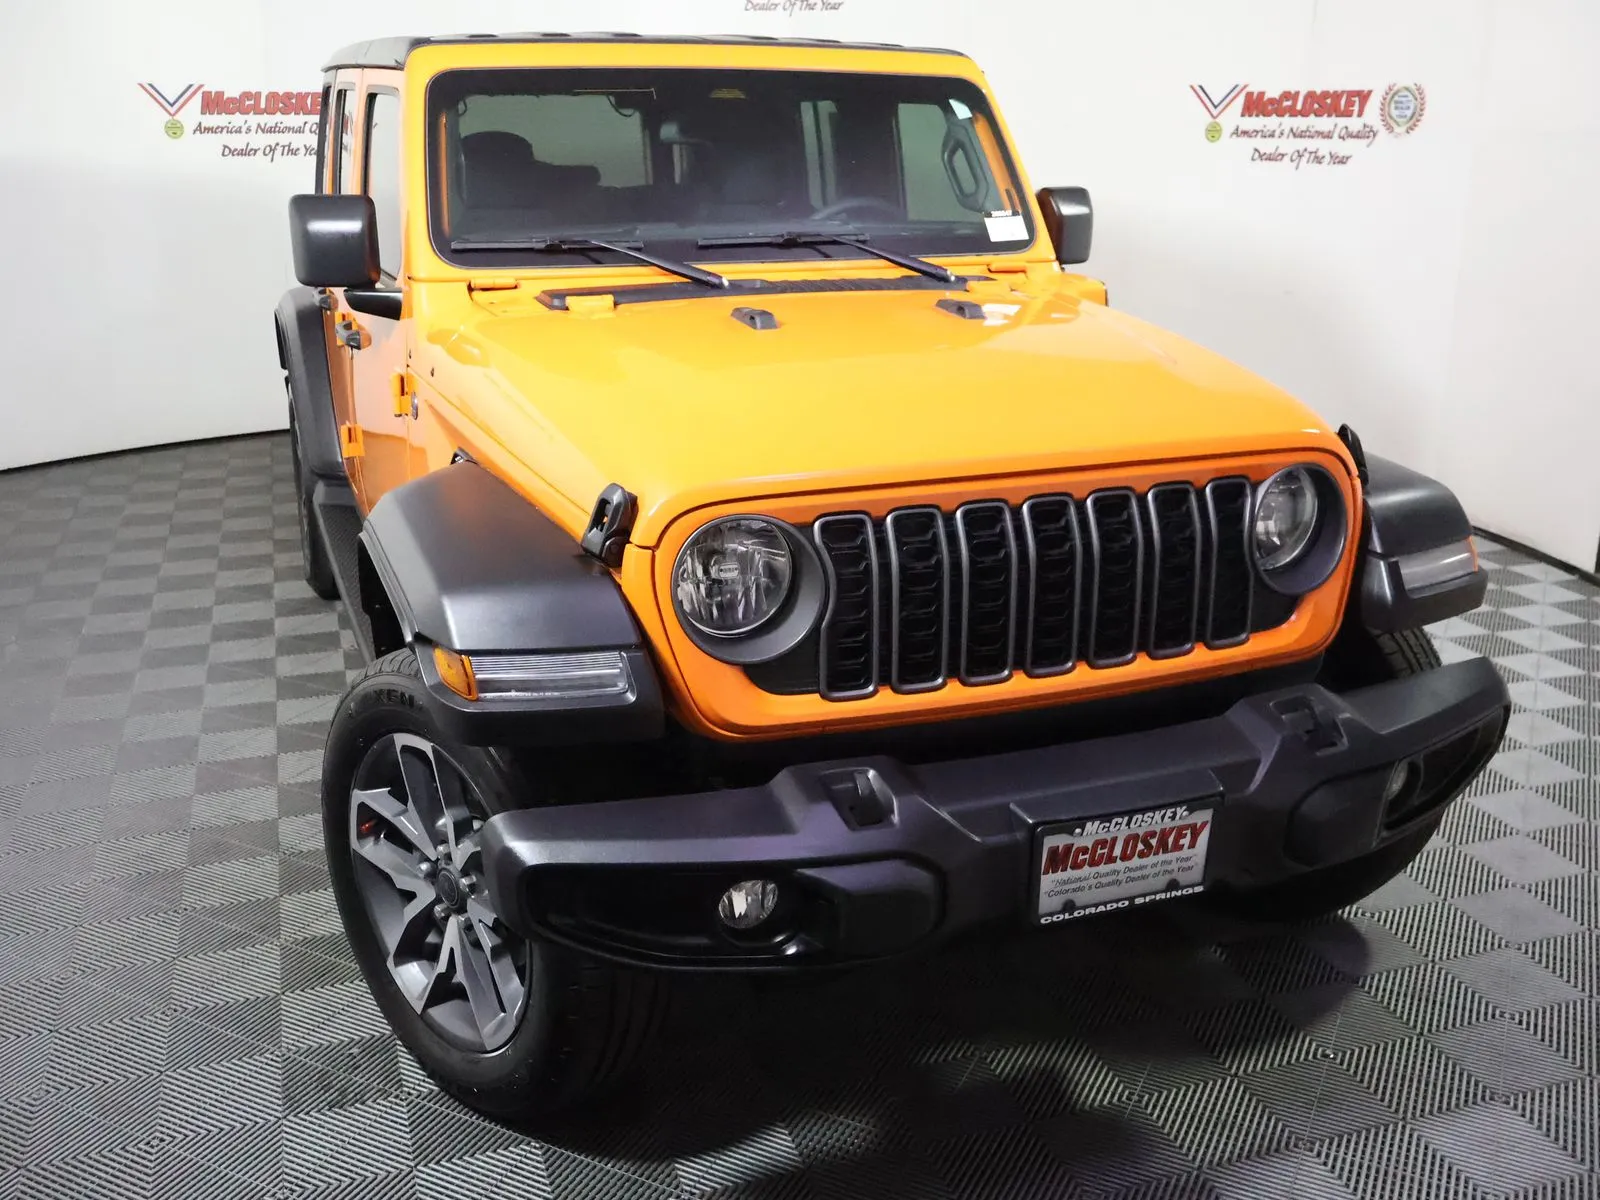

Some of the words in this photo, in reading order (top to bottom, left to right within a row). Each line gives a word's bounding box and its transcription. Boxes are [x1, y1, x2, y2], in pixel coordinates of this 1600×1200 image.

[744, 0, 780, 11] Dealer
[782, 0, 797, 17] Of
[799, 0, 818, 11] The
[820, 0, 844, 11] Year
[200, 91, 321, 116] McCLOSKE
[1240, 89, 1373, 118] McCLOSKEY
[192, 119, 252, 135] America's
[255, 122, 307, 135] National
[1230, 122, 1285, 140] America's
[1287, 123, 1336, 141] National
[1338, 122, 1378, 148] Quality
[221, 142, 260, 157] Dealer
[263, 144, 280, 163] Of
[280, 142, 300, 157] The
[303, 144, 318, 157] Yea
[1250, 146, 1288, 162] Dealer
[1290, 147, 1308, 170] Of
[1307, 148, 1326, 165] The
[1326, 150, 1352, 166] Year
[1082, 805, 1188, 837] McCLOSKEY
[1042, 820, 1209, 876] McCLOSKEY
[1092, 868, 1121, 881] Quality
[1123, 861, 1149, 874] Dealer
[1160, 858, 1174, 868] the
[1094, 878, 1123, 892] Quality
[1124, 872, 1150, 885] Dealer
[1161, 867, 1175, 877] the
[1040, 899, 1129, 924] COLORADO
[1133, 884, 1205, 905] SPRINGS
